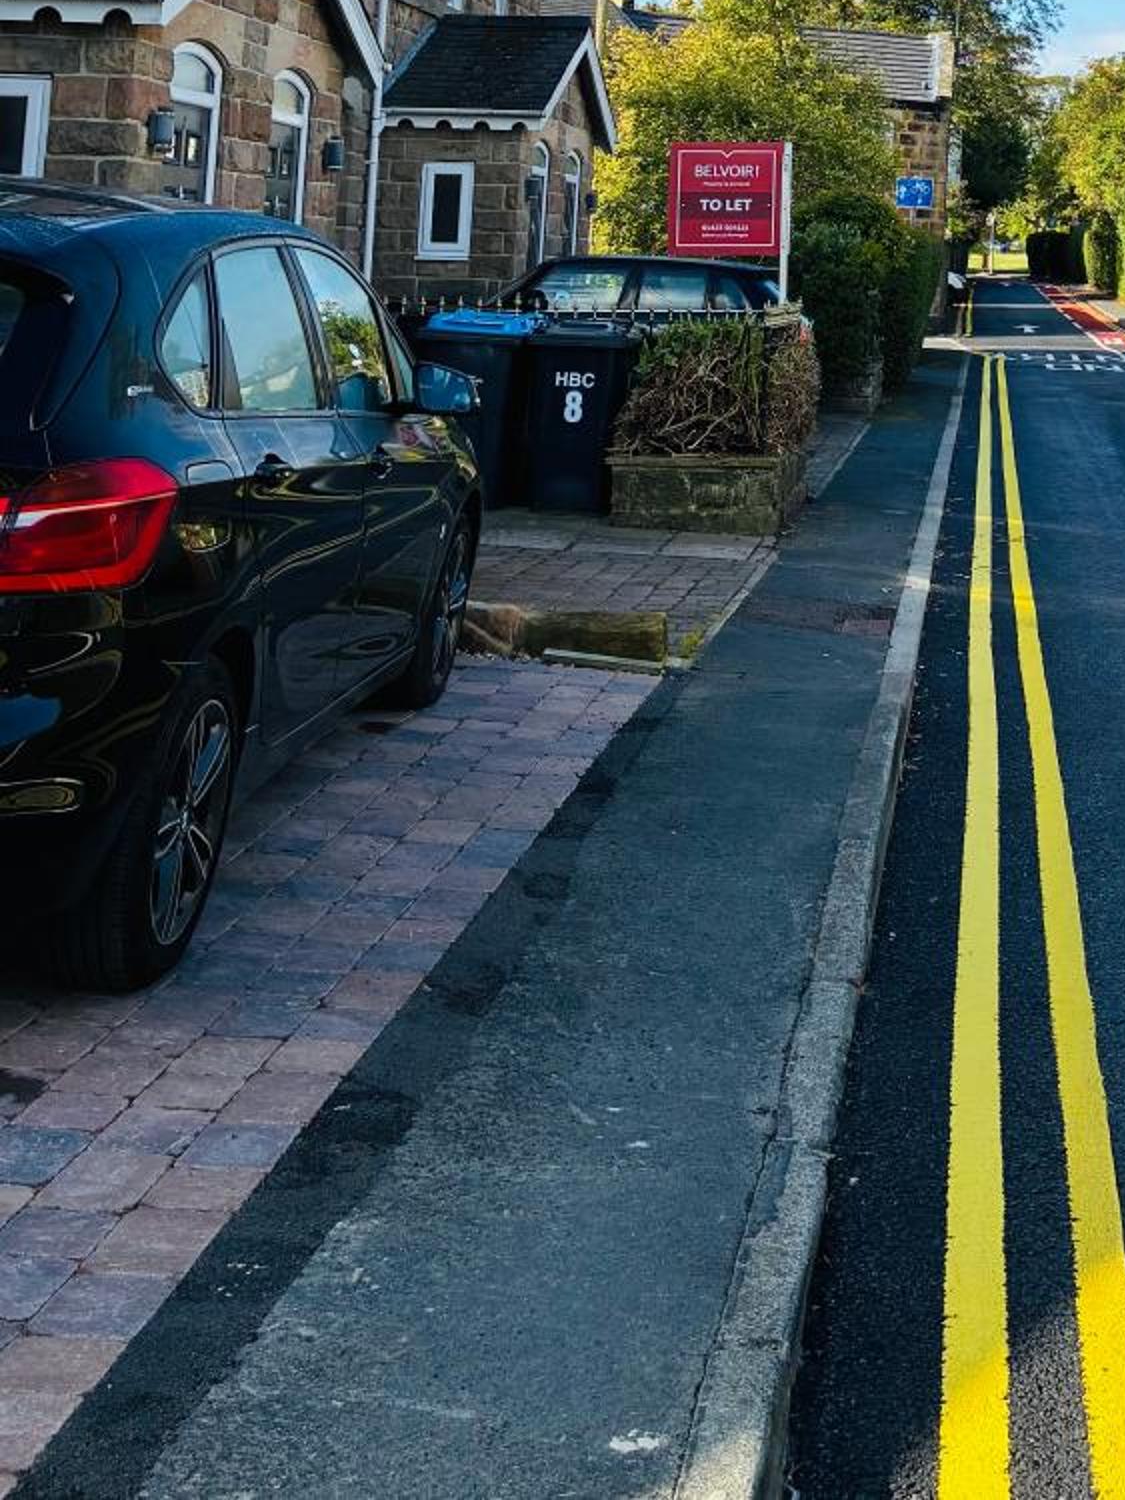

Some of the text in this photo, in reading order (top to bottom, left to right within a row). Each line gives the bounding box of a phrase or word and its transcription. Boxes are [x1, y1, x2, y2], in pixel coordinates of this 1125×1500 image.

[699, 198, 752, 211] TO LET
[555, 371, 595, 389] HBC
[563, 390, 583, 423] 8
